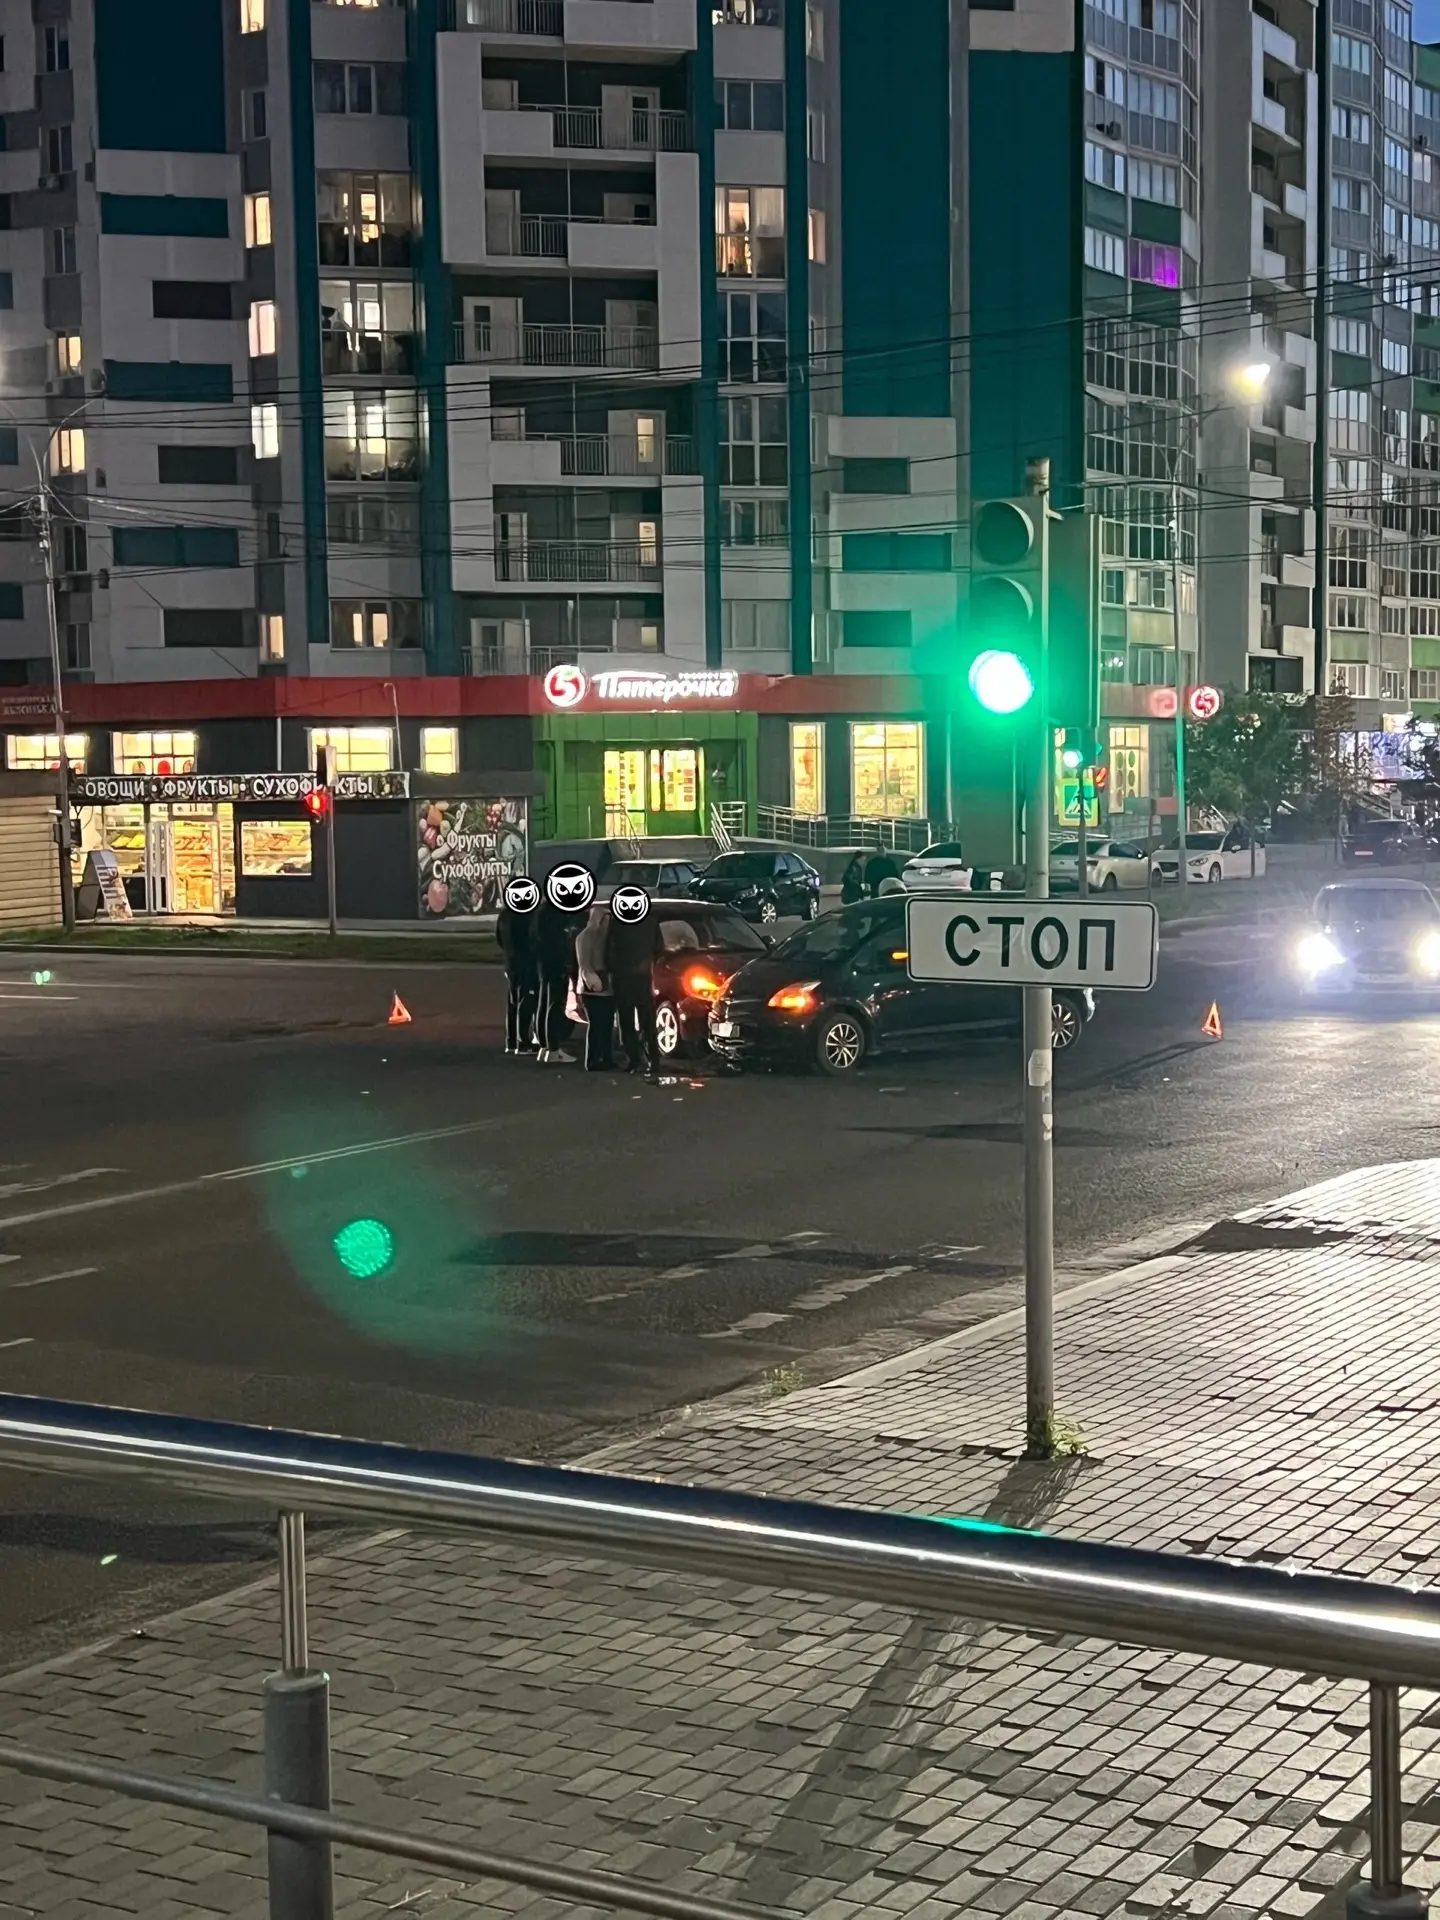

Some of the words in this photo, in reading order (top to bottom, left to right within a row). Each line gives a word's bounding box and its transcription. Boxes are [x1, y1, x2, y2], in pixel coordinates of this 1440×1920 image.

[591, 671, 736, 703] Пятерочка
[85, 780, 145, 798] ОВОЩИ
[164, 779, 233, 797] ФРУКТЫ
[253, 776, 373, 796] СУХОФРКТЫ
[446, 830, 497, 851] Фрукты
[432, 860, 512, 882] Сухофрукты
[945, 914, 1115, 971] СТОП
